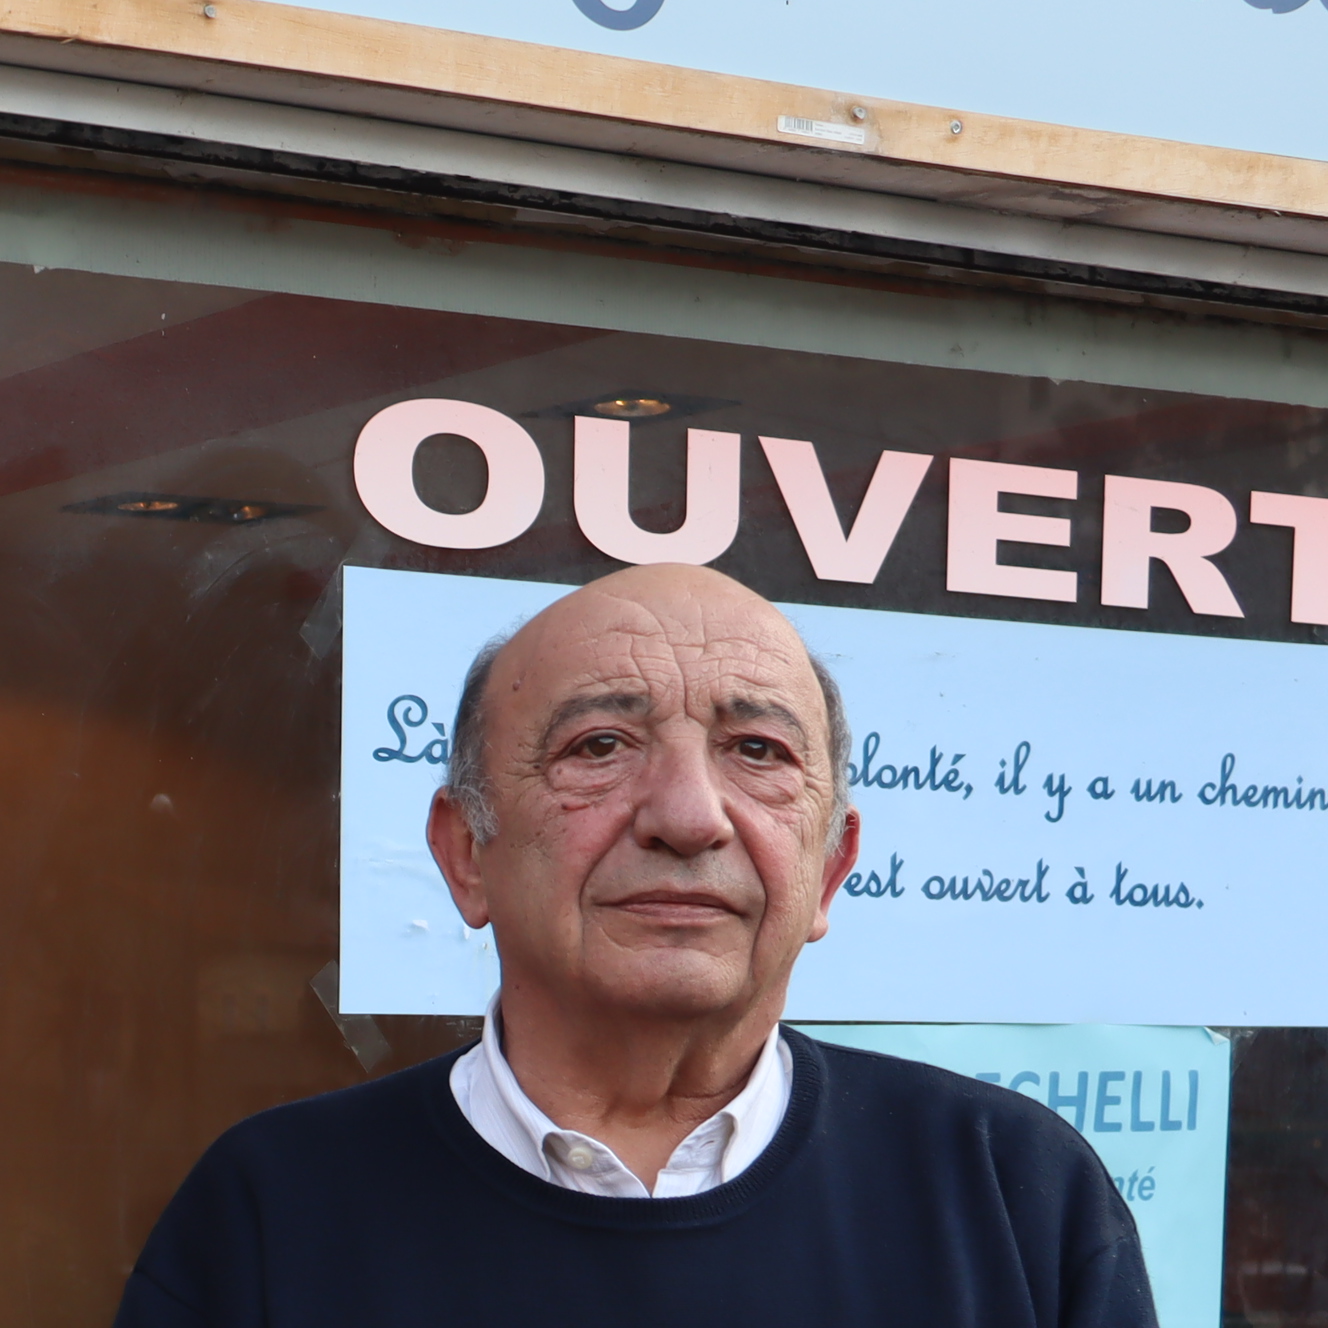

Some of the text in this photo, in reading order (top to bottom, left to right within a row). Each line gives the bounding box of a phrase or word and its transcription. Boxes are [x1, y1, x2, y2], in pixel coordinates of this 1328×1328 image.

[994, 740, 1031, 796] il
[1043, 773, 1071, 822] y
[1087, 775, 1115, 799] a
[1130, 774, 1183, 804] un
[921, 858, 1050, 902] ouvert
[1065, 866, 1095, 904] à
[1109, 862, 1205, 910] tous.
[975, 1070, 1199, 1132] HELLI
